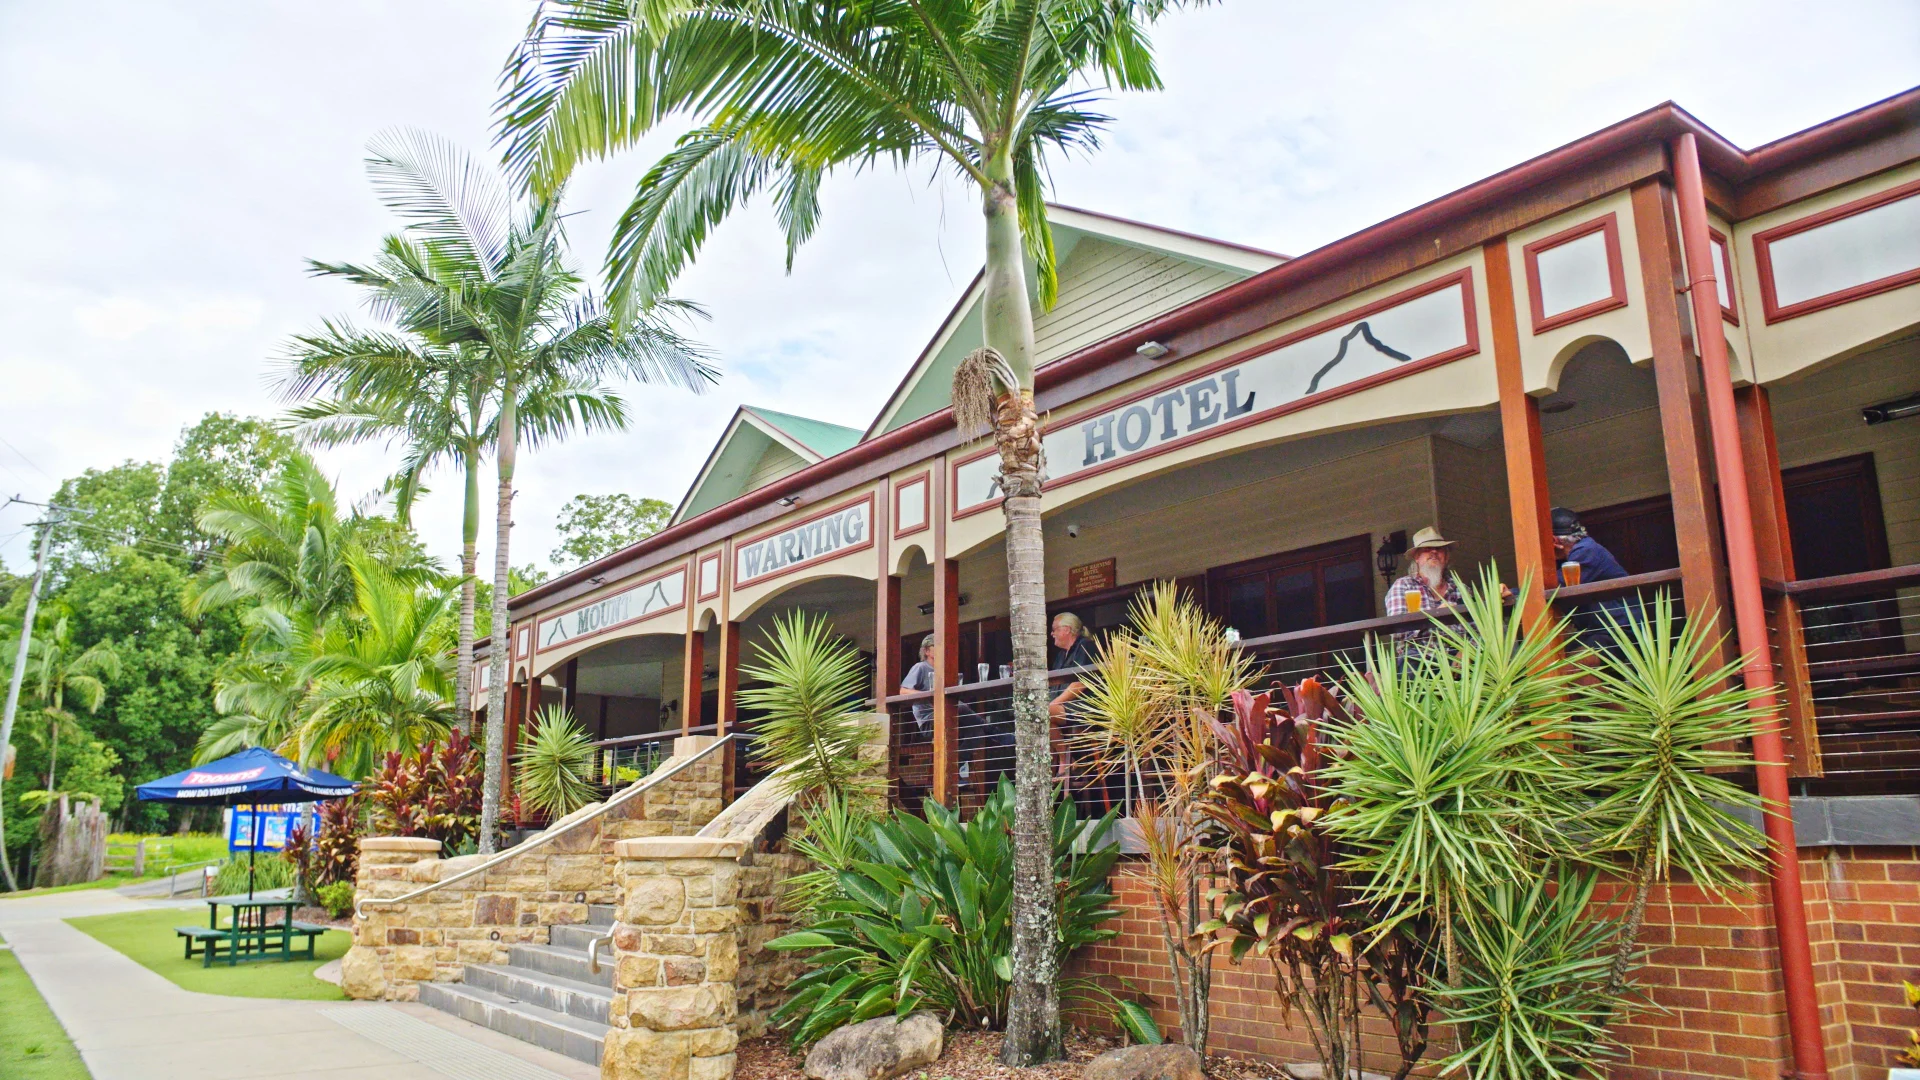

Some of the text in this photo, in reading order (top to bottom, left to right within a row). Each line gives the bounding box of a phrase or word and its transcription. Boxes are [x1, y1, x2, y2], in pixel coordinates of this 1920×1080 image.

[1082, 368, 1256, 467] HOTEL
[743, 506, 864, 578] WARNING
[577, 593, 632, 635] MOUNT
[176, 789, 197, 798] HOW
[197, 789, 209, 798] DO
[209, 787, 226, 797] YOU
